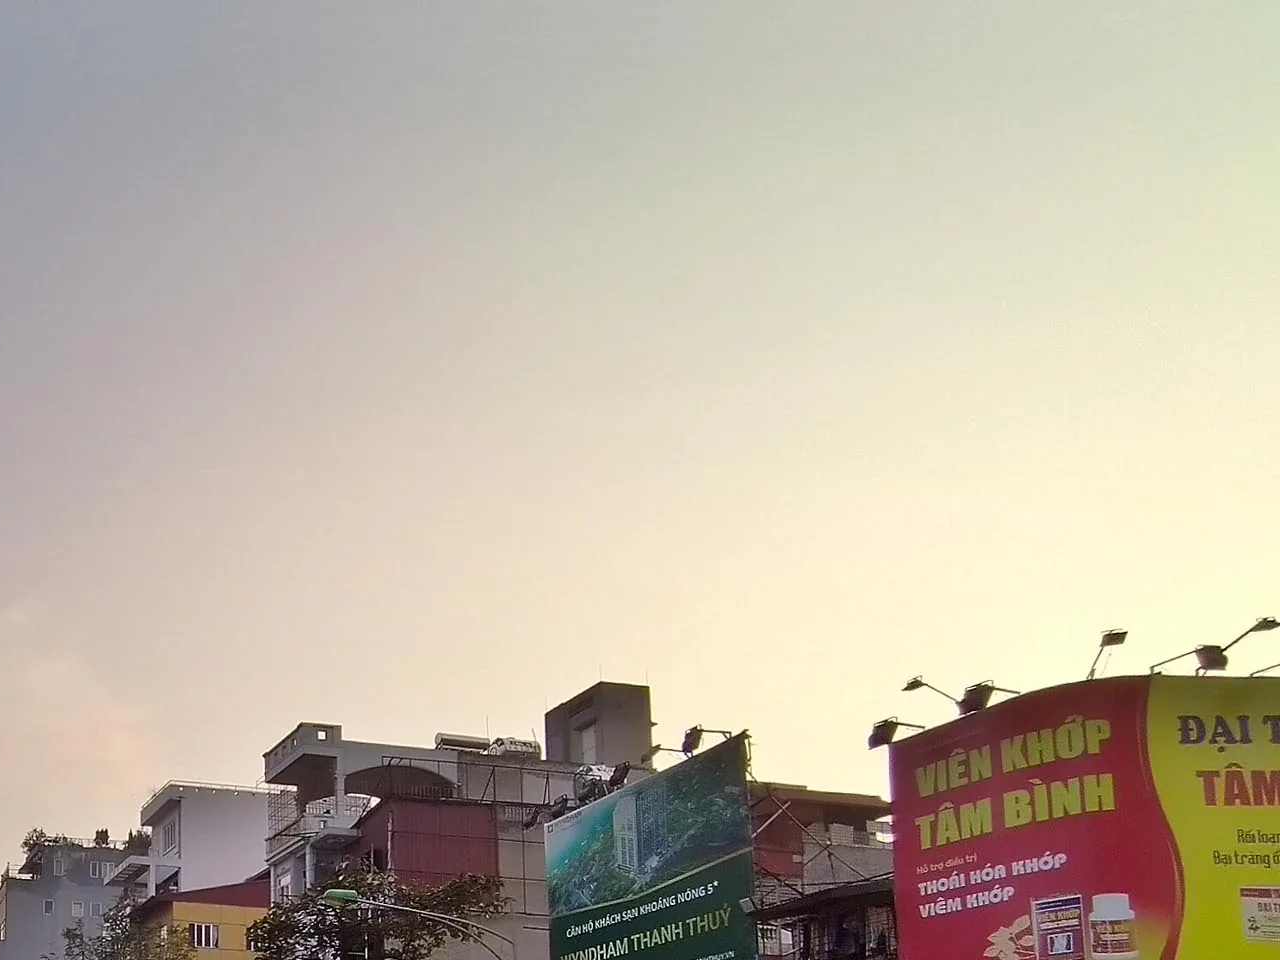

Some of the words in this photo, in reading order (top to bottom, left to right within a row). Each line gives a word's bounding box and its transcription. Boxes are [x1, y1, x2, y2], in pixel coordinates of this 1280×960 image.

[916, 747, 992, 798] VIÊN
[1000, 714, 1111, 773] KHỚP
[1177, 714, 1252, 753] ĐẠI
[914, 800, 993, 850] TÂM
[1003, 773, 1115, 828] BÌNH
[918, 872, 966, 896] THOÁI
[970, 864, 1006, 885] HÓA
[1012, 851, 1067, 876] KHỚP
[582, 919, 594, 932] HỘ
[594, 911, 621, 929] KHÁCH
[622, 907, 639, 922] SẠN
[639, 894, 676, 917] KHOÁNG
[678, 886, 706, 904] NÓNG
[919, 893, 962, 918] VIÊM
[967, 884, 1015, 909] KHỚP
[631, 921, 683, 951] THANH
